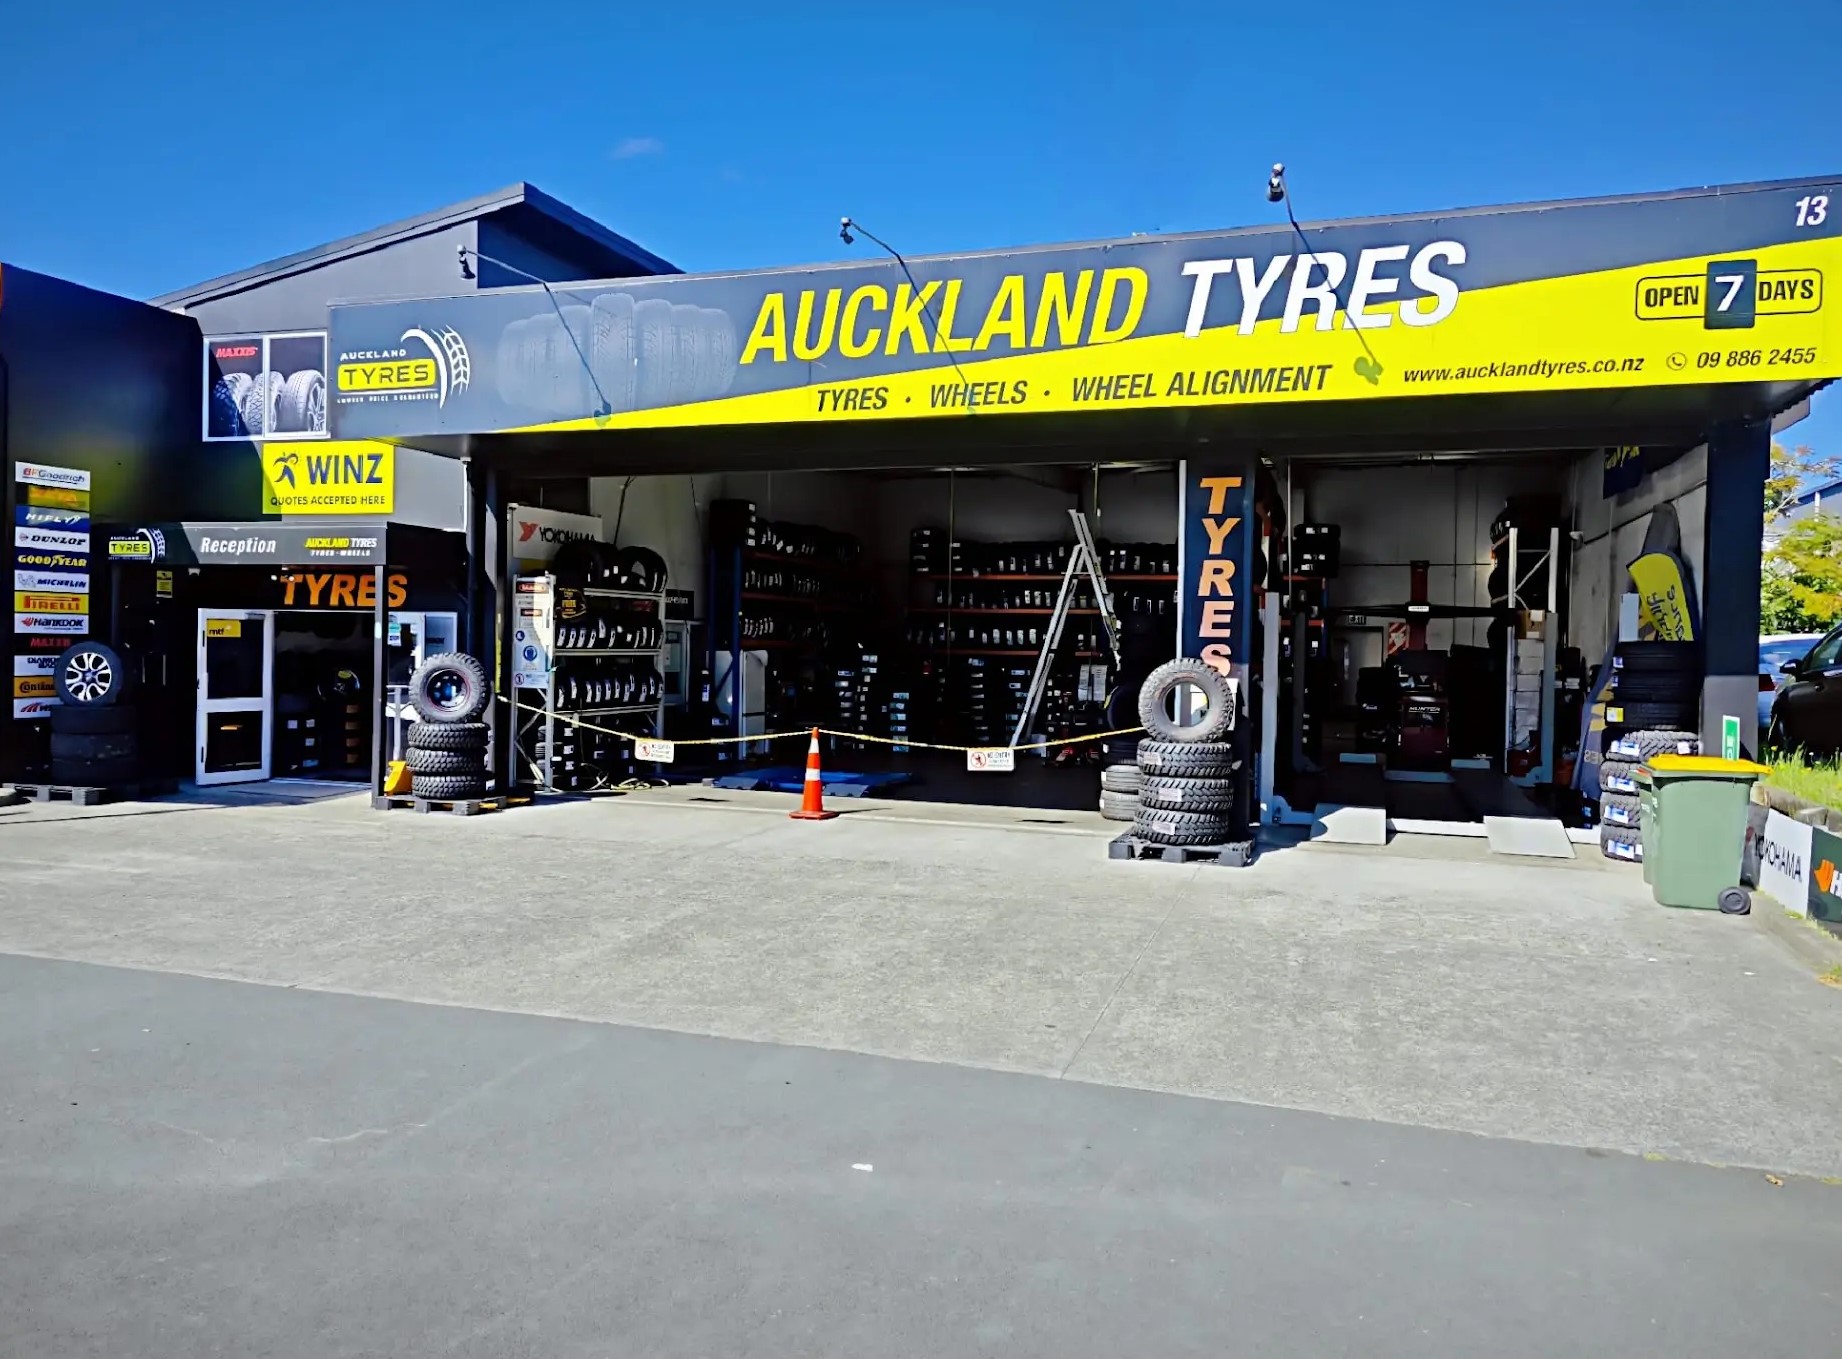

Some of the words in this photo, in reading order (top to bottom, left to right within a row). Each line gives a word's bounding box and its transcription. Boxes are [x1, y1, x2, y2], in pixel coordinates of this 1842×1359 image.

[1795, 196, 1829, 226] 13
[740, 266, 1149, 365] AUCKLAND
[1181, 240, 1468, 339] TYRES
[1645, 286, 1699, 308] OPEN
[1714, 275, 1745, 312] 7
[1759, 279, 1814, 301] DAYS
[216, 346, 258, 357] MAXXIS
[340, 349, 406, 361] AUCKLAND
[1697, 352, 1721, 368] 09
[1727, 350, 1762, 367] 886
[1768, 347, 1817, 365] 2455
[343, 364, 429, 385] TYRES
[1404, 357, 1645, 383] www.aucklandtyres.co.nz
[818, 386, 889, 412] TYRES
[930, 380, 1029, 409] WHEELS
[1073, 373, 1157, 402] WHEEL
[1166, 364, 1333, 397] ALIGNMENT
[306, 453, 384, 485] WINZ
[271, 495, 308, 506] QUOTES
[310, 494, 357, 505] ACCEPTED
[361, 495, 386, 504] HERE
[31, 535, 87, 546] DUNLOP
[111, 543, 149, 553] TYRES
[201, 537, 277, 555] Reception
[304, 538, 349, 548] AUCKLAND
[350, 538, 378, 548] TYRES
[17, 554, 88, 568] GOODYEAR
[37, 578, 87, 589] MICHELIN
[1198, 476, 1242, 679] TYRES
[280, 574, 408, 608] TYRES
[24, 595, 81, 611] PIRELLI
[1348, 615, 1365, 624] EXIT
[1755, 832, 1803, 882] YOKOHAMA
